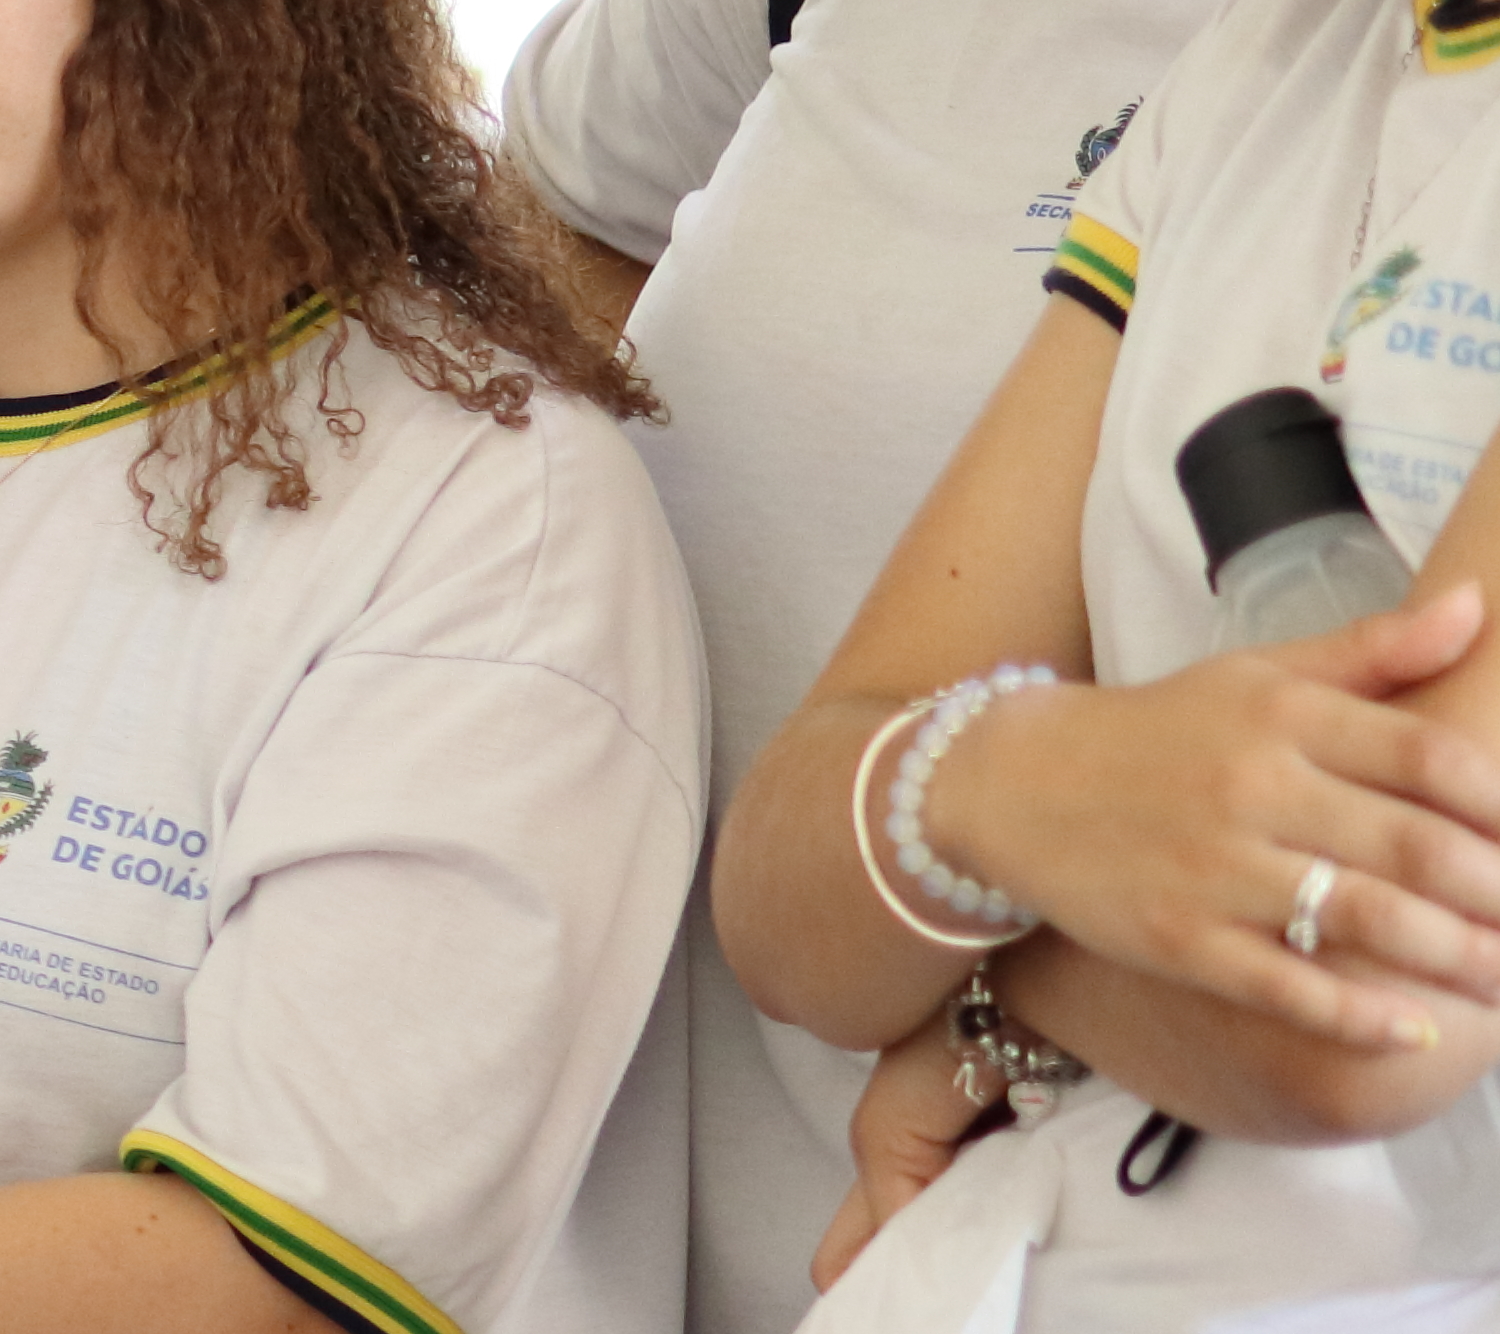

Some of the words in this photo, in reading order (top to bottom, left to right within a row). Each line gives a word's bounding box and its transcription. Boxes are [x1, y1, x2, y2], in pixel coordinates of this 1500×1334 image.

[1385, 321, 1440, 359] DE
[66, 795, 208, 859] ESTADO
[51, 835, 106, 873] DE
[110, 853, 210, 901] GOIÁS
[46, 953, 75, 973] DE
[78, 961, 160, 996] ESTADO
